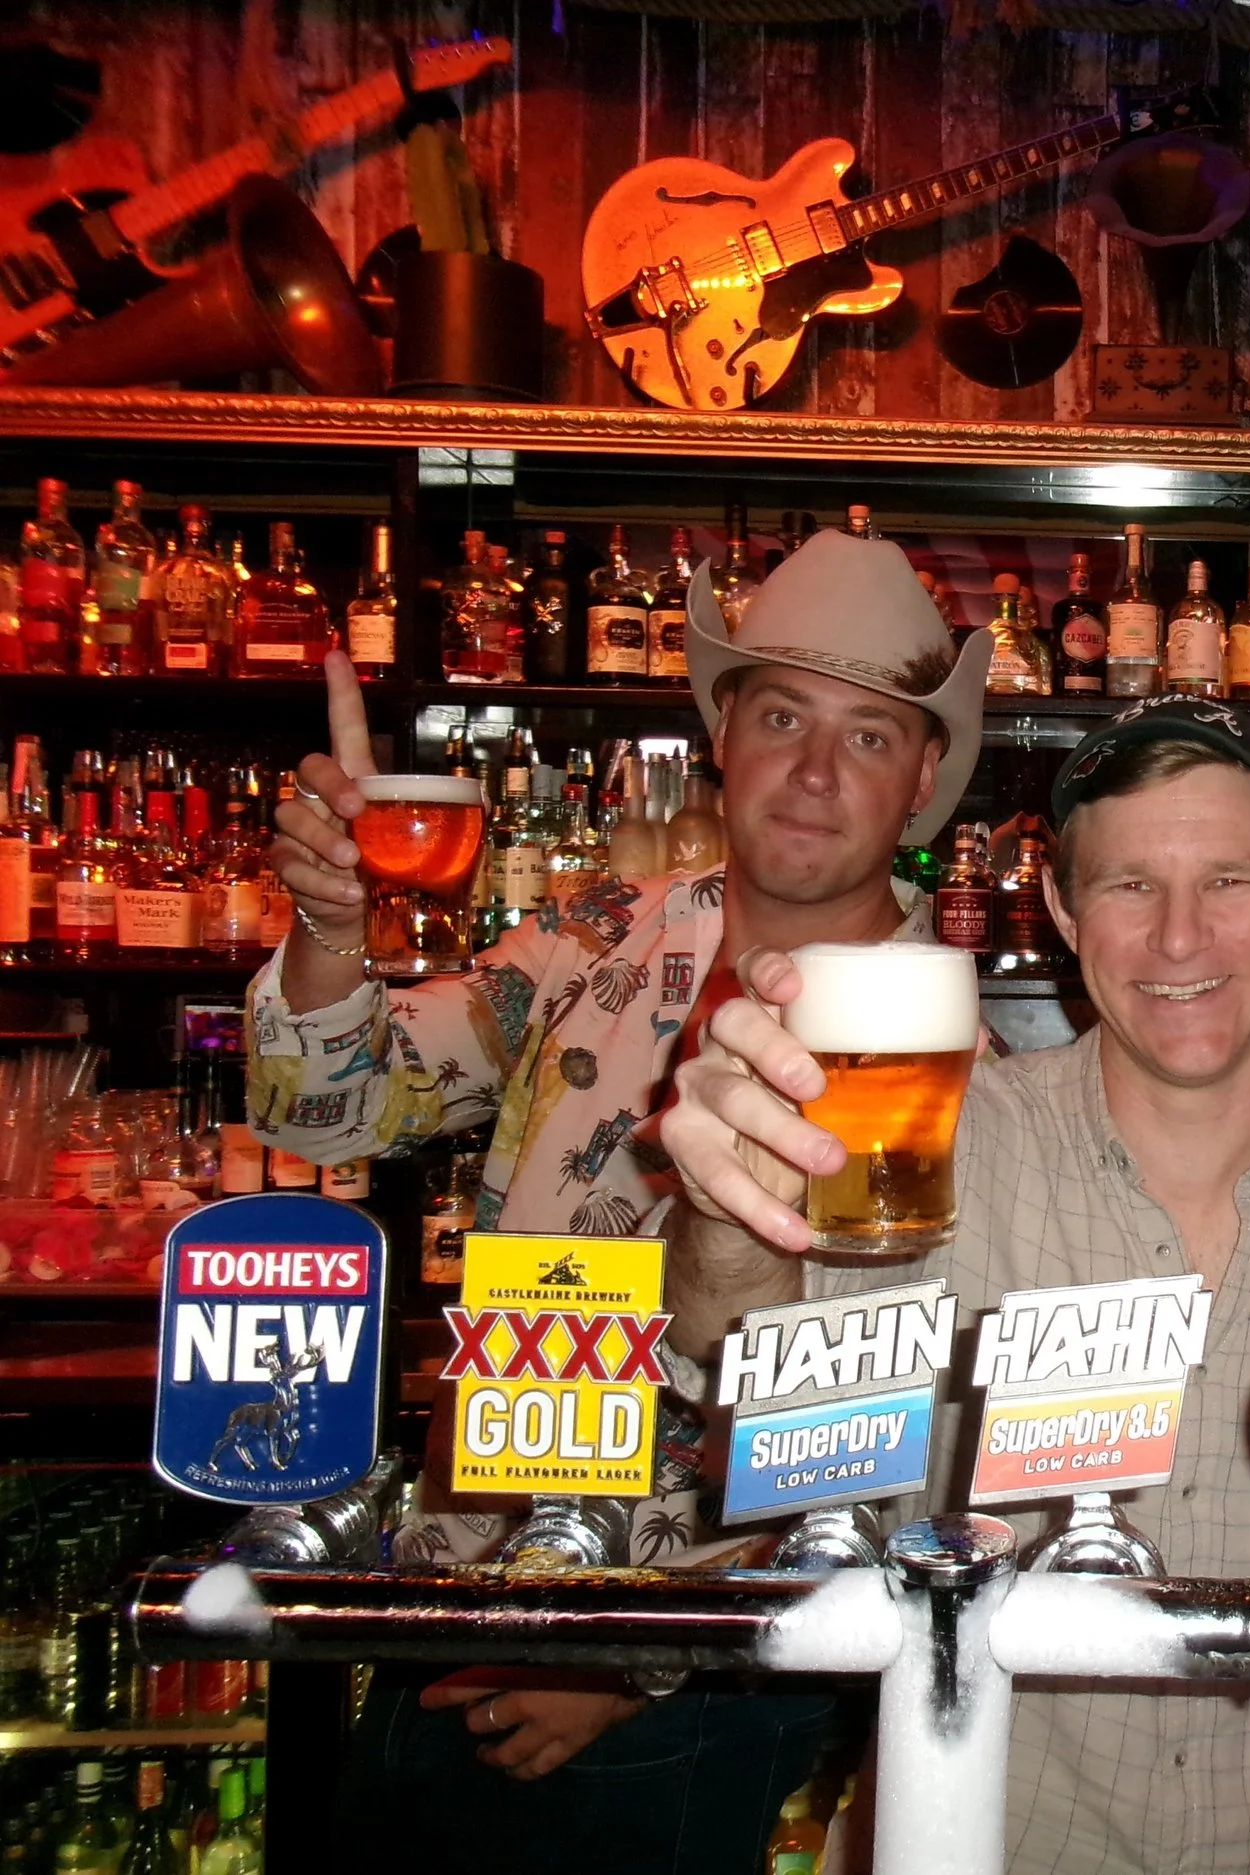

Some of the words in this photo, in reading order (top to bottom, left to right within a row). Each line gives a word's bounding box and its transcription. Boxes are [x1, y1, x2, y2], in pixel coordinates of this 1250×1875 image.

[990, 661, 1021, 670] ATRÓN
[123, 895, 182, 907] Maker's
[138, 907, 181, 918] Mark
[959, 910, 987, 919] PILLARS
[943, 920, 986, 930] BLOODY
[187, 1250, 361, 1288] TOOHEYS
[489, 1288, 571, 1300] CASTLEMAINE
[576, 1291, 632, 1303] BREWERY
[172, 1303, 367, 1384] NEW
[440, 1306, 675, 1386] XXXX
[718, 1293, 959, 1406] HAHN
[971, 1291, 1214, 1387] HAHN
[464, 1388, 643, 1461] GOLD
[750, 1408, 909, 1470] SuperDry
[987, 1407, 1125, 1457] SuperDry
[1126, 1400, 1173, 1441] 3.5
[461, 1465, 498, 1477] FULL
[505, 1466, 588, 1479] FLAVOURED
[596, 1468, 642, 1481] LAGER
[775, 1467, 818, 1490] LOW
[823, 1458, 876, 1479] CARB
[1024, 1453, 1067, 1475] LOW
[1071, 1449, 1124, 1470] CARB
[184, 1463, 266, 1492] REFRESHING
